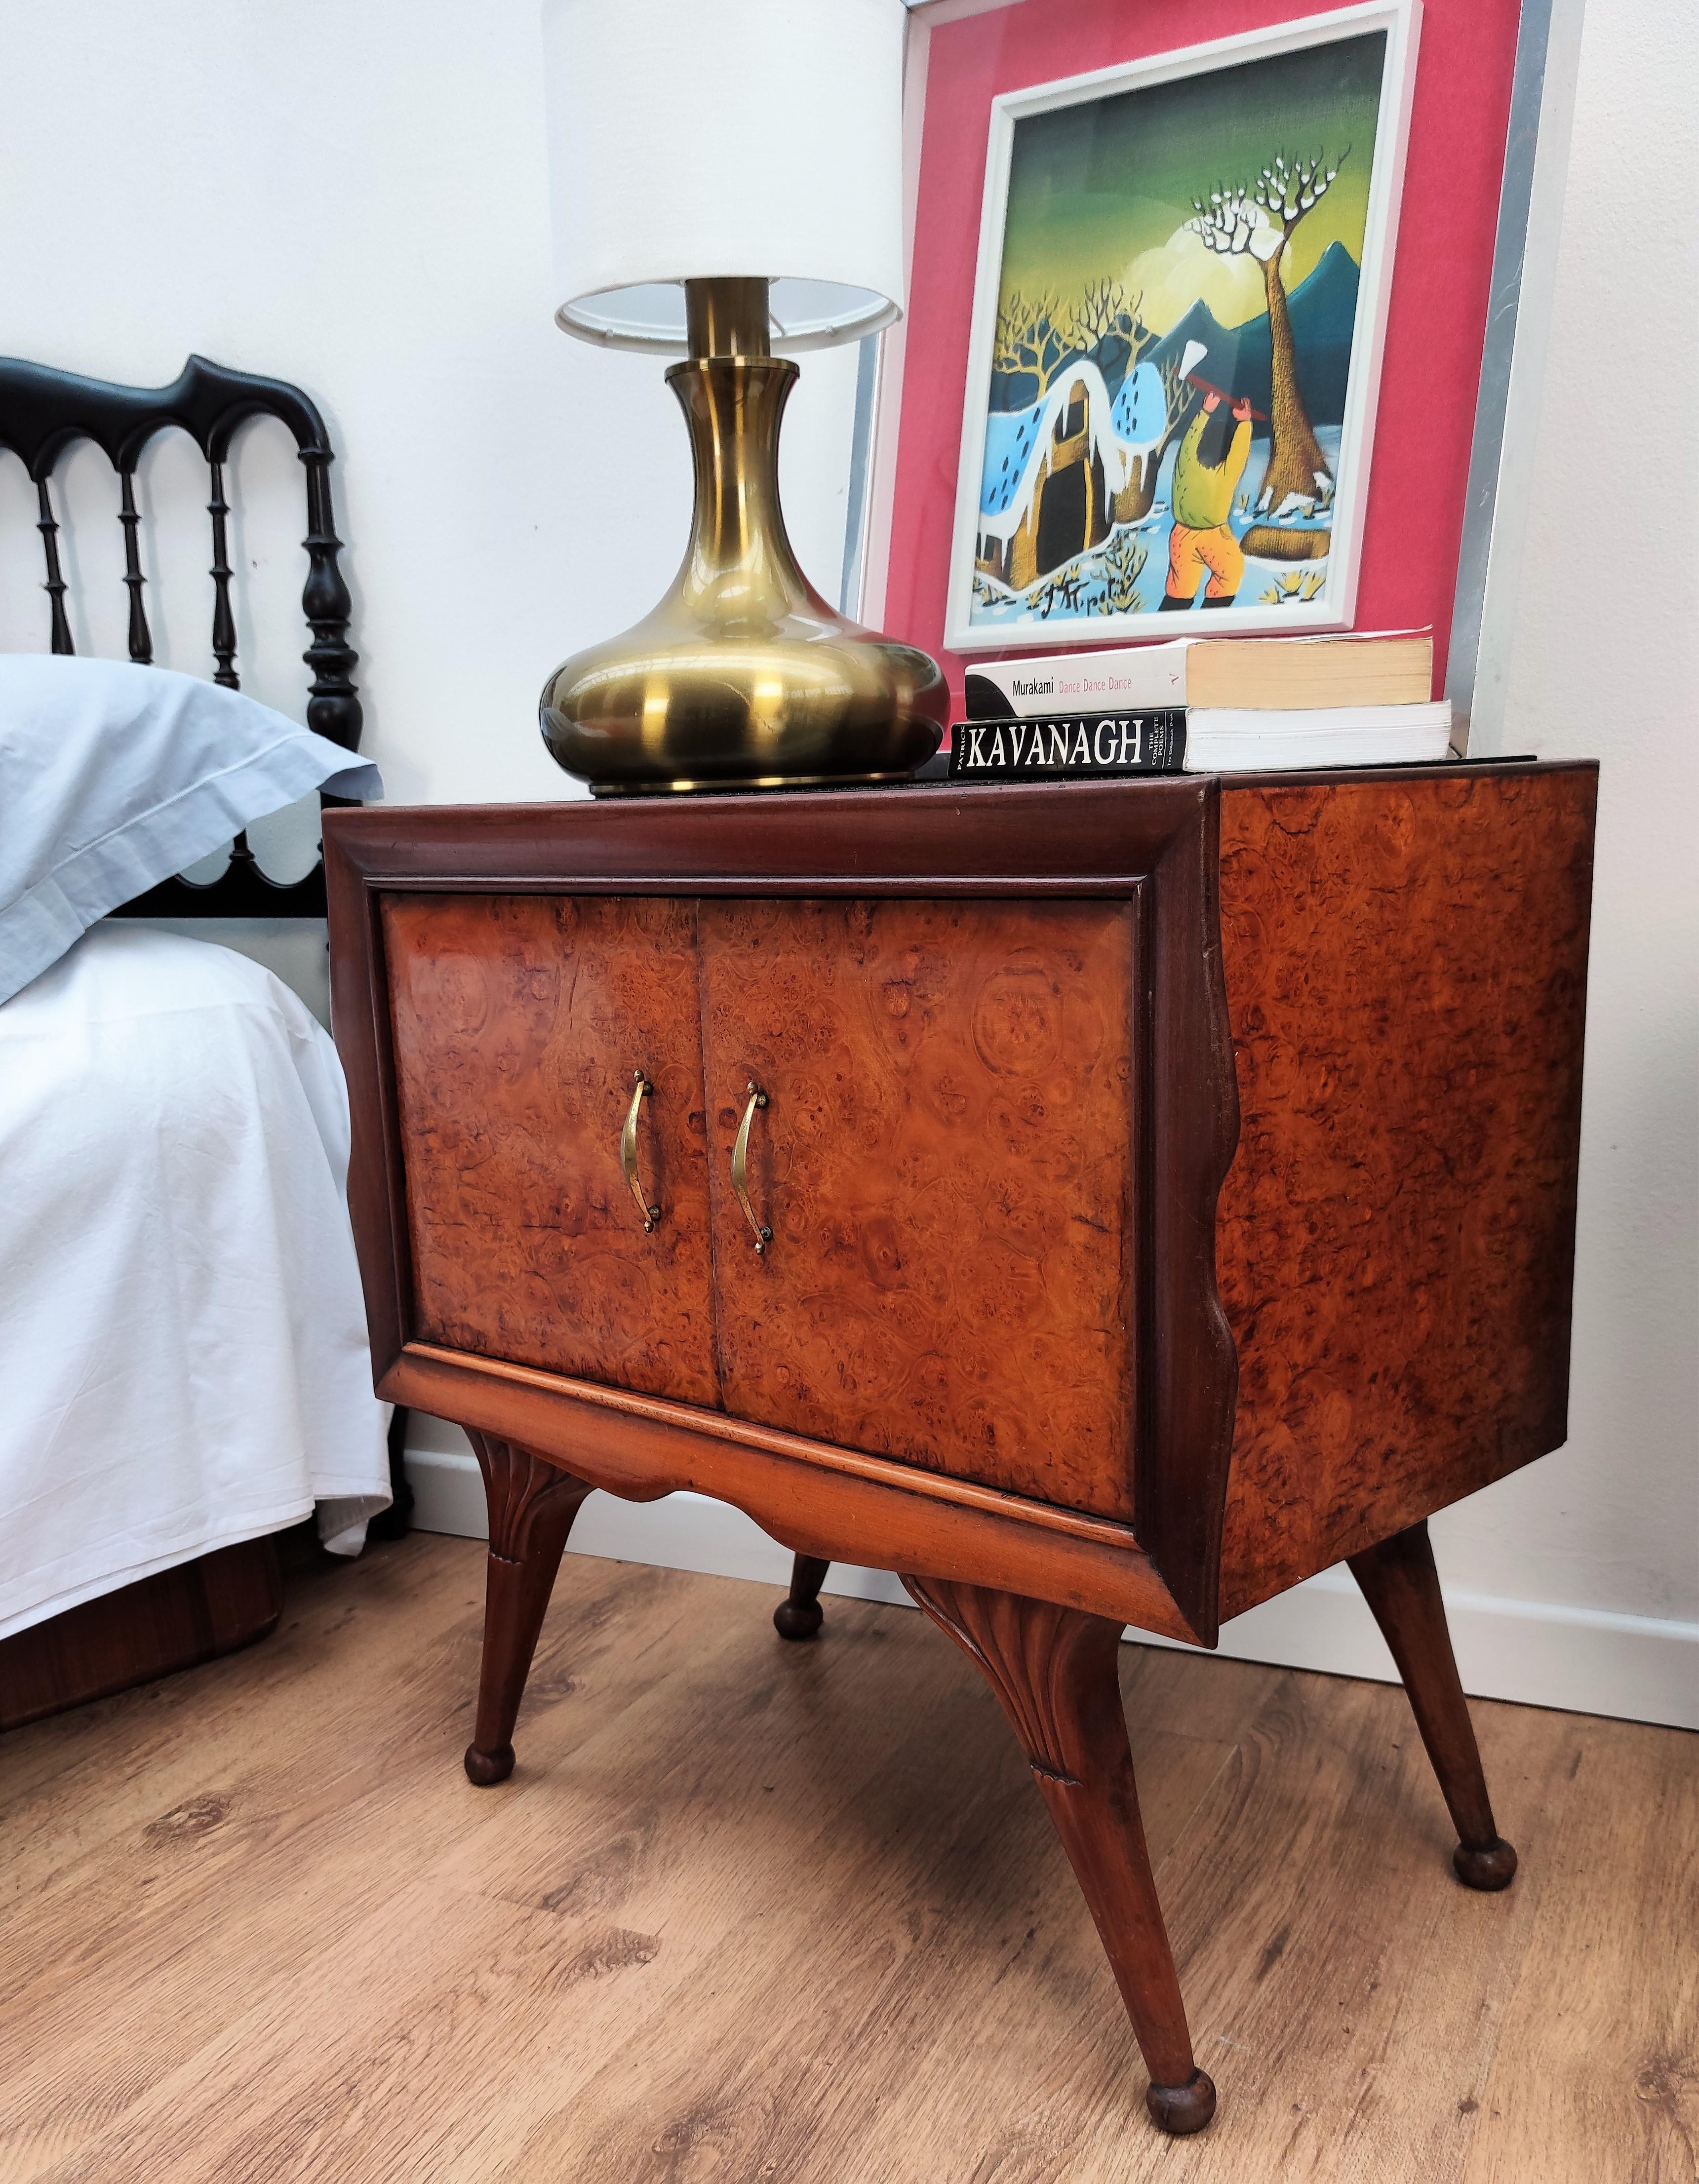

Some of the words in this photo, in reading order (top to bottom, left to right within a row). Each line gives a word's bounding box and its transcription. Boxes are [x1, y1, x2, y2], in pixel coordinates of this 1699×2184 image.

[1013, 676, 1054, 696] Murakami
[1059, 681, 1080, 694] Dance
[1083, 679, 1106, 692] Dance
[1109, 677, 1132, 690] Dance
[957, 725, 965, 770] PATRICK
[966, 720, 1144, 767] KAVANAGH
